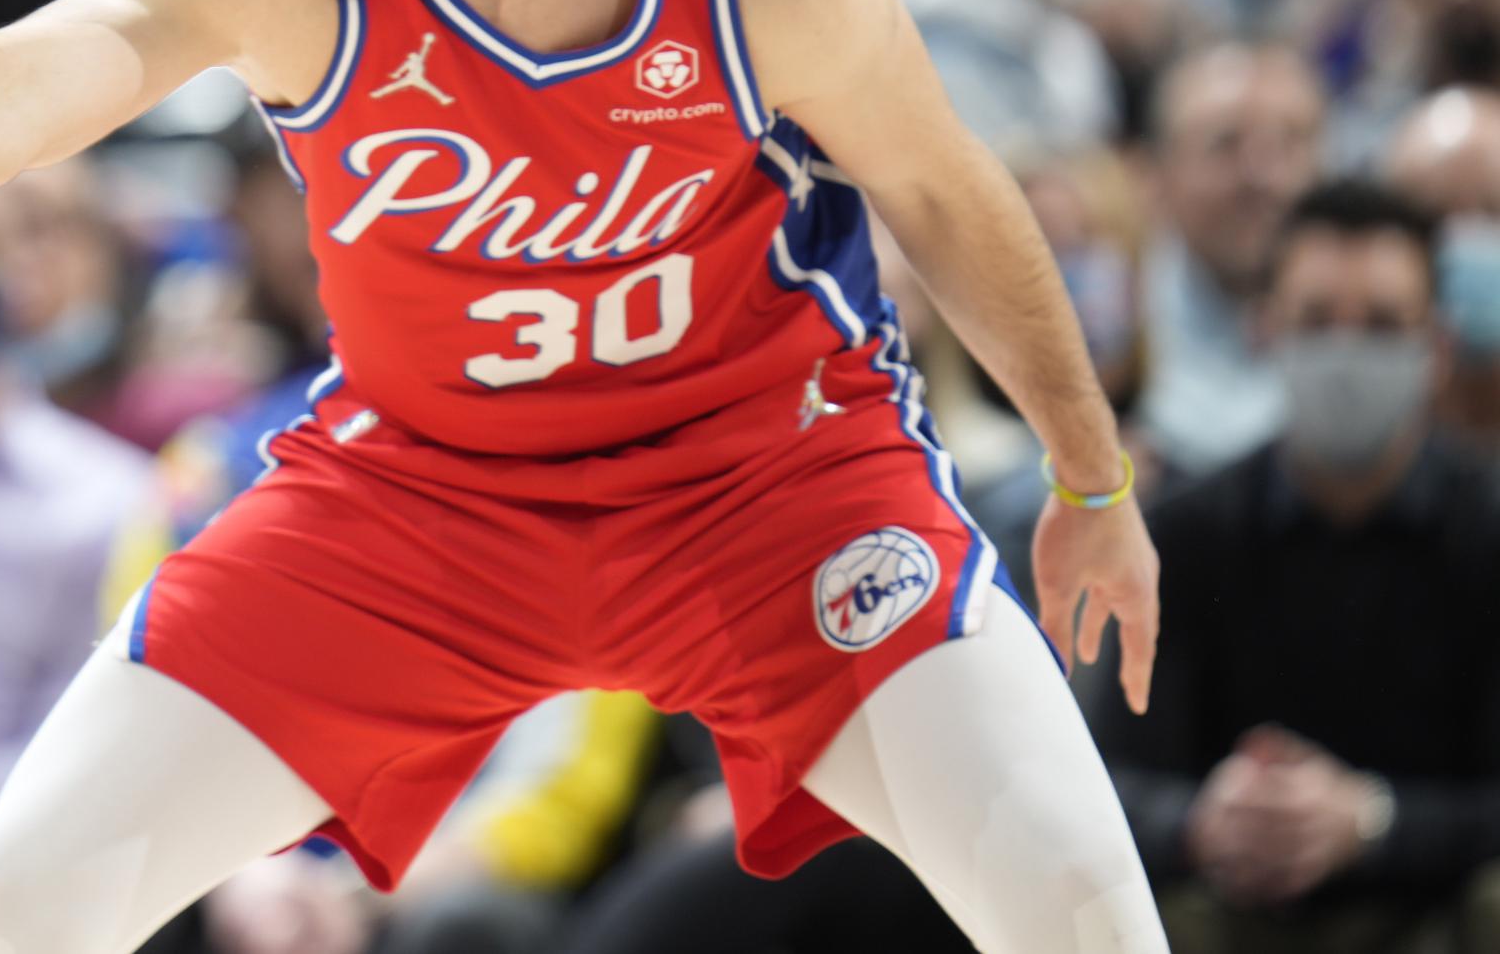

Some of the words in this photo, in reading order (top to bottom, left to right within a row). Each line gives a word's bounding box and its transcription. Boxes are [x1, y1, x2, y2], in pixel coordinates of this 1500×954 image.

[610, 102, 726, 124] crypto.com
[326, 126, 716, 265] Phila
[463, 252, 695, 390] 30
